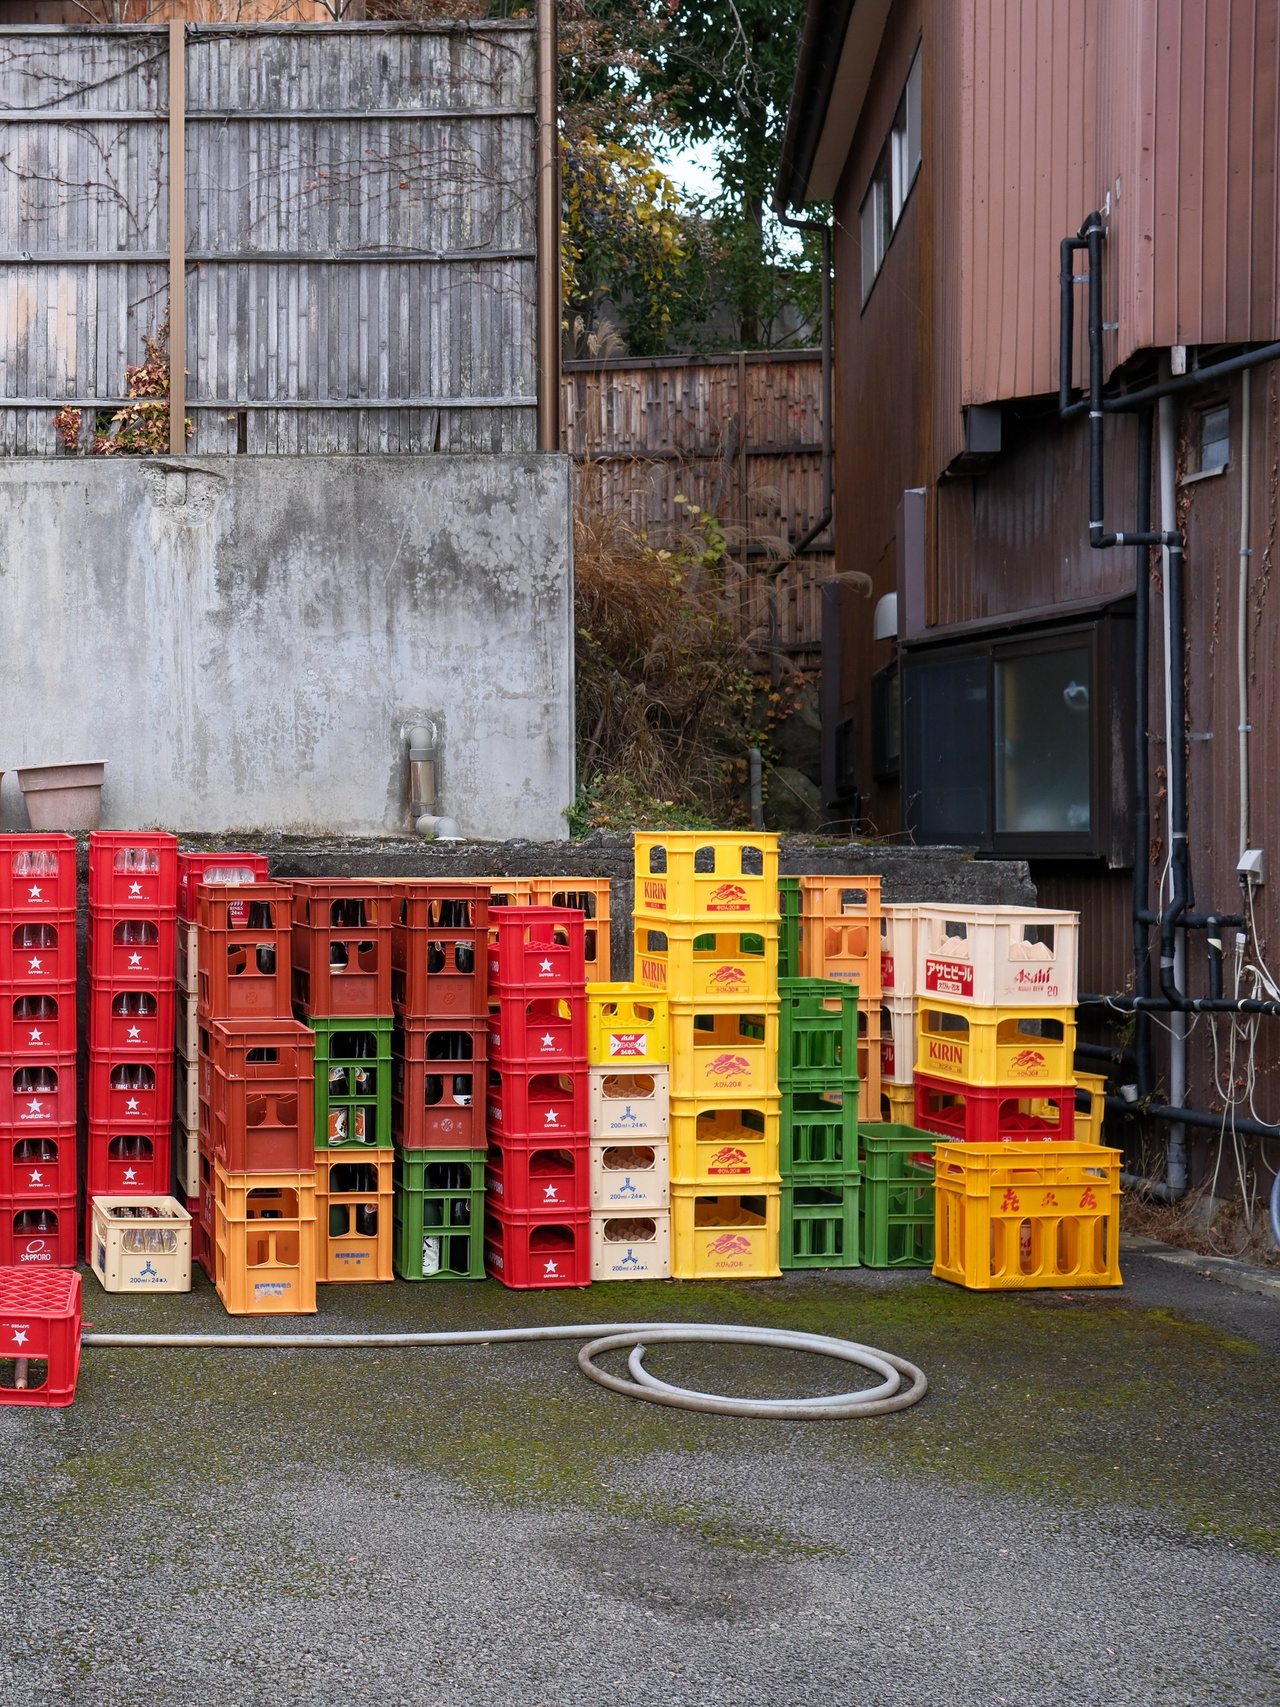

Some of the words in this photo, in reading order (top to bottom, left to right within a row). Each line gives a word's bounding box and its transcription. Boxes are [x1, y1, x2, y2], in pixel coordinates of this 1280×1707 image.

[644, 881, 666, 901] KIRIN
[642, 959, 666, 983] KIRIN
[927, 961, 972, 982] アサヒビール
[1014, 967, 1053, 984] Asahi
[1047, 985, 1058, 997] 20
[929, 1041, 963, 1065] KIRIN
